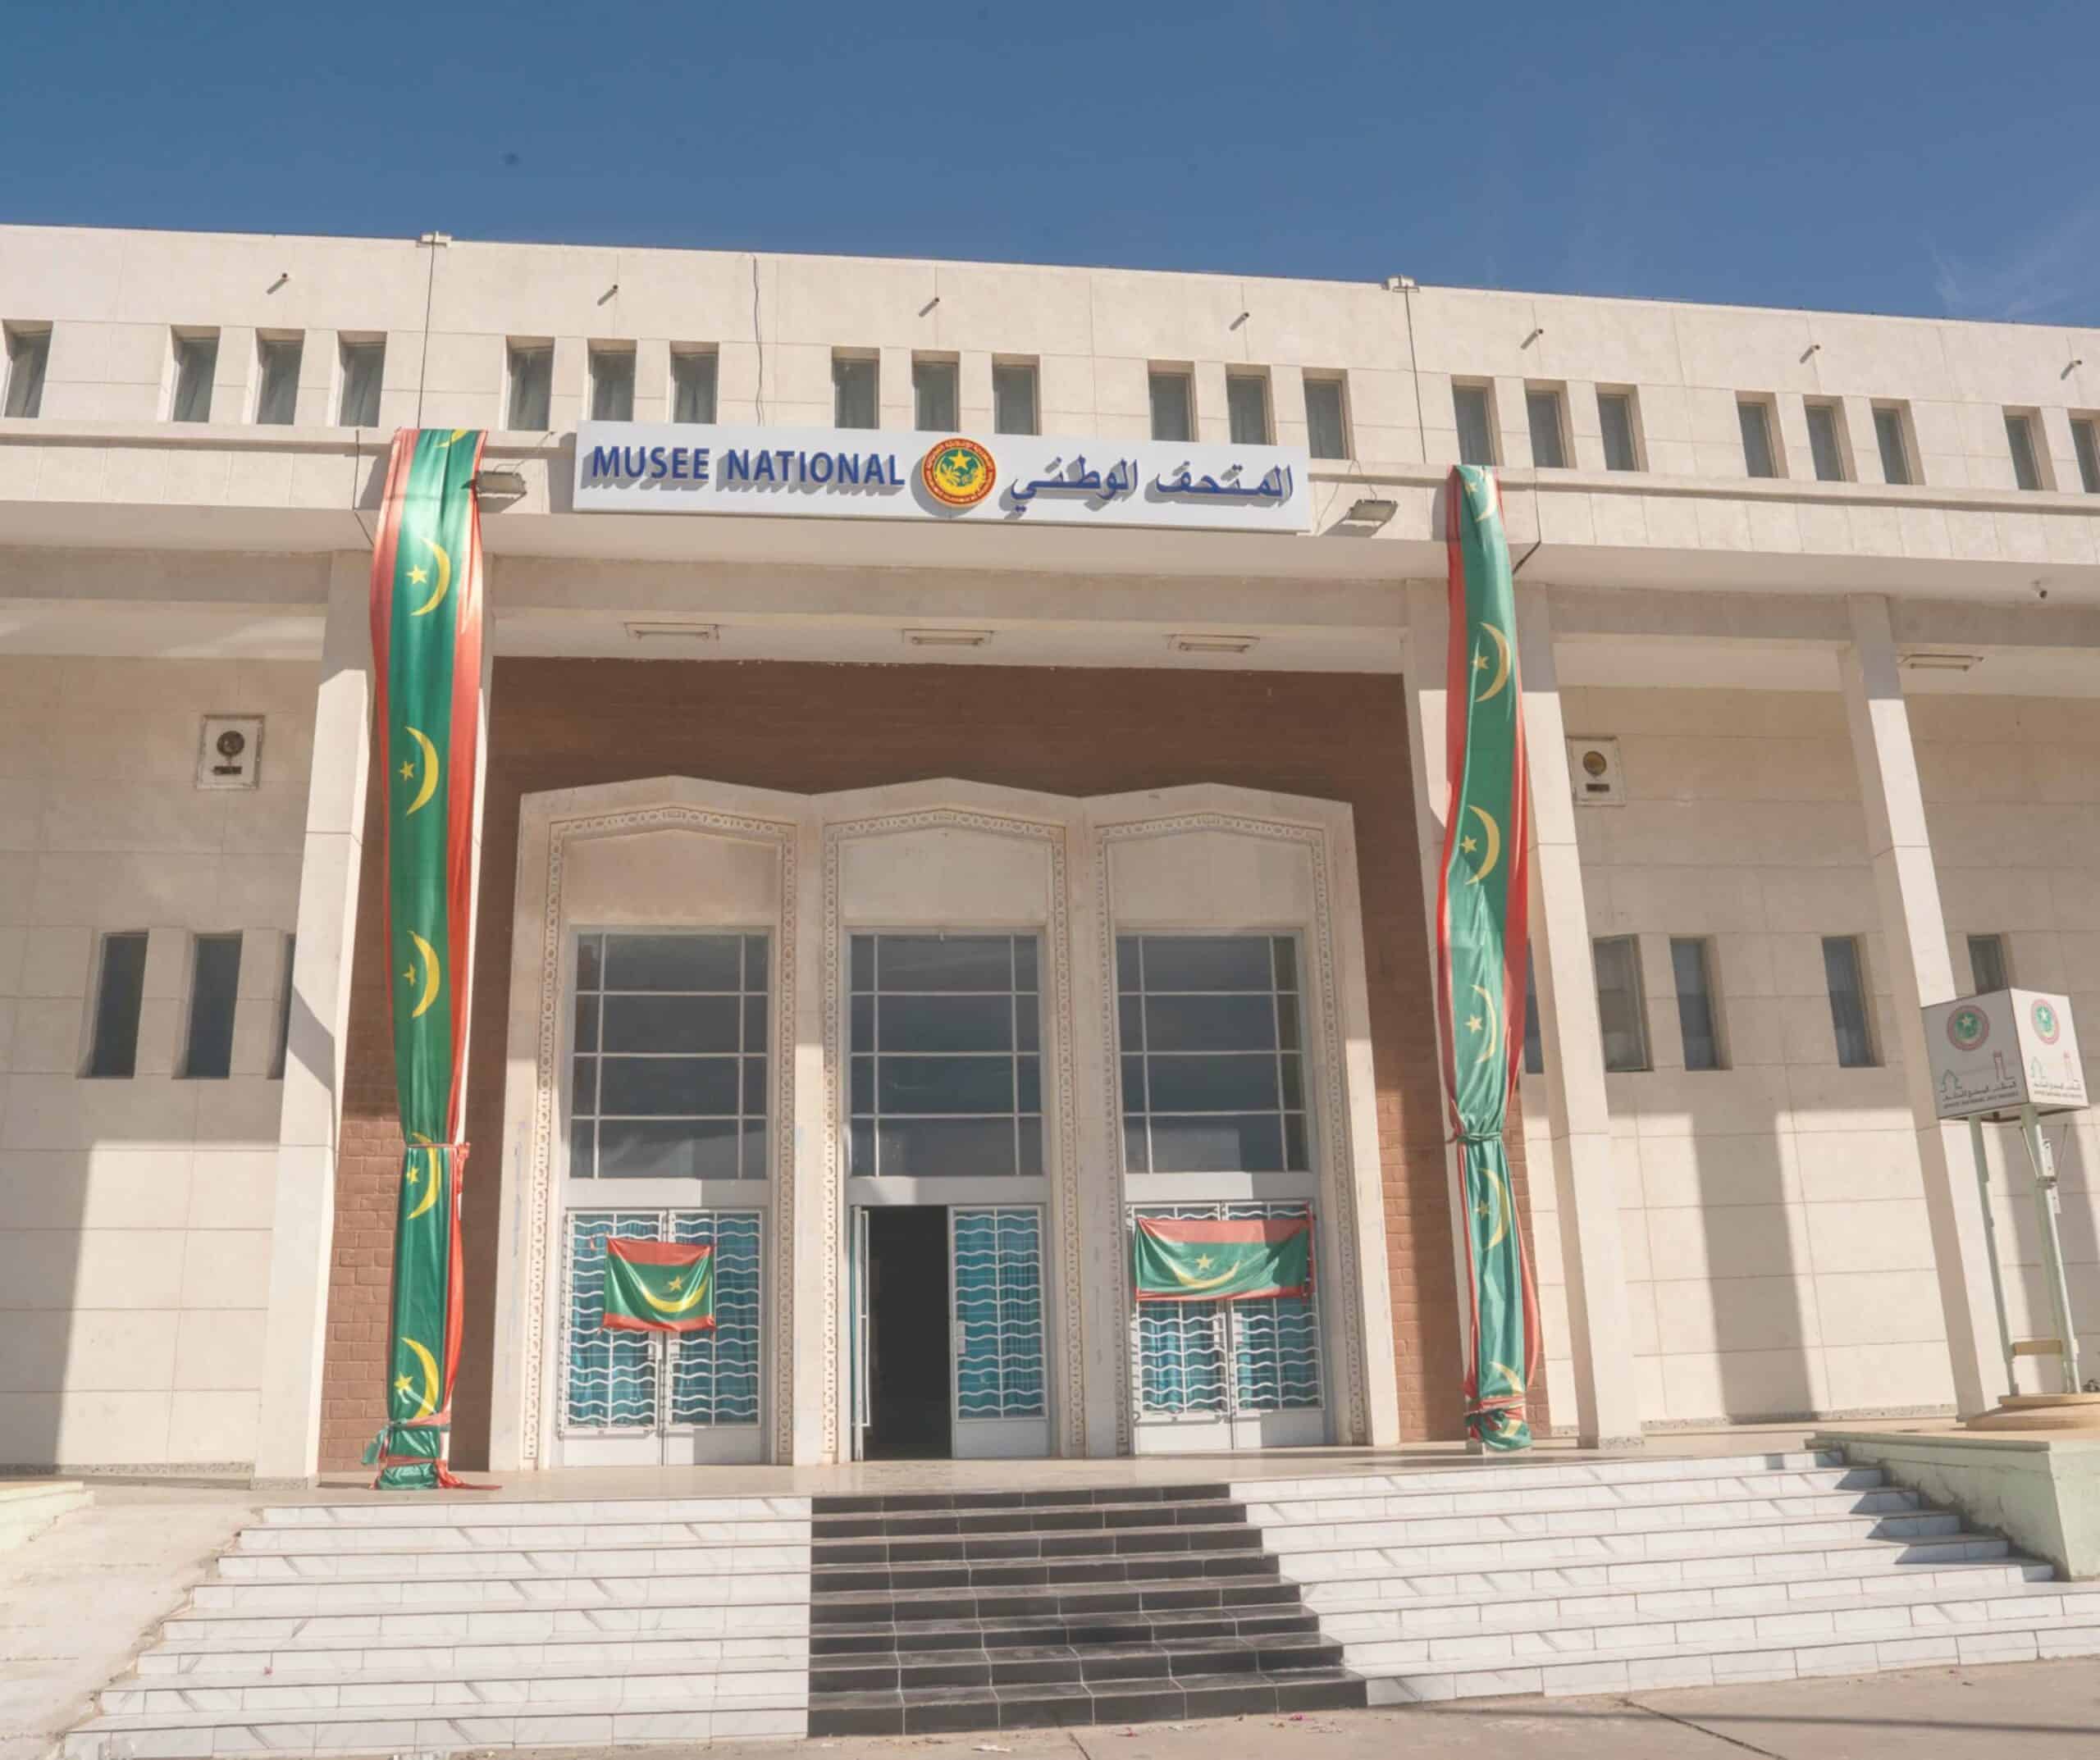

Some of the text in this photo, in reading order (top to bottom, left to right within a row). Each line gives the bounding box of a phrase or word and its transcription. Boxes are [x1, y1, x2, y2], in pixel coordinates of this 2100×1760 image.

[592, 445, 710, 481] MUSEE
[726, 449, 906, 486] NATIONAL
[1010, 454, 1139, 513] الوطني
[1155, 460, 1294, 498] المتحف
